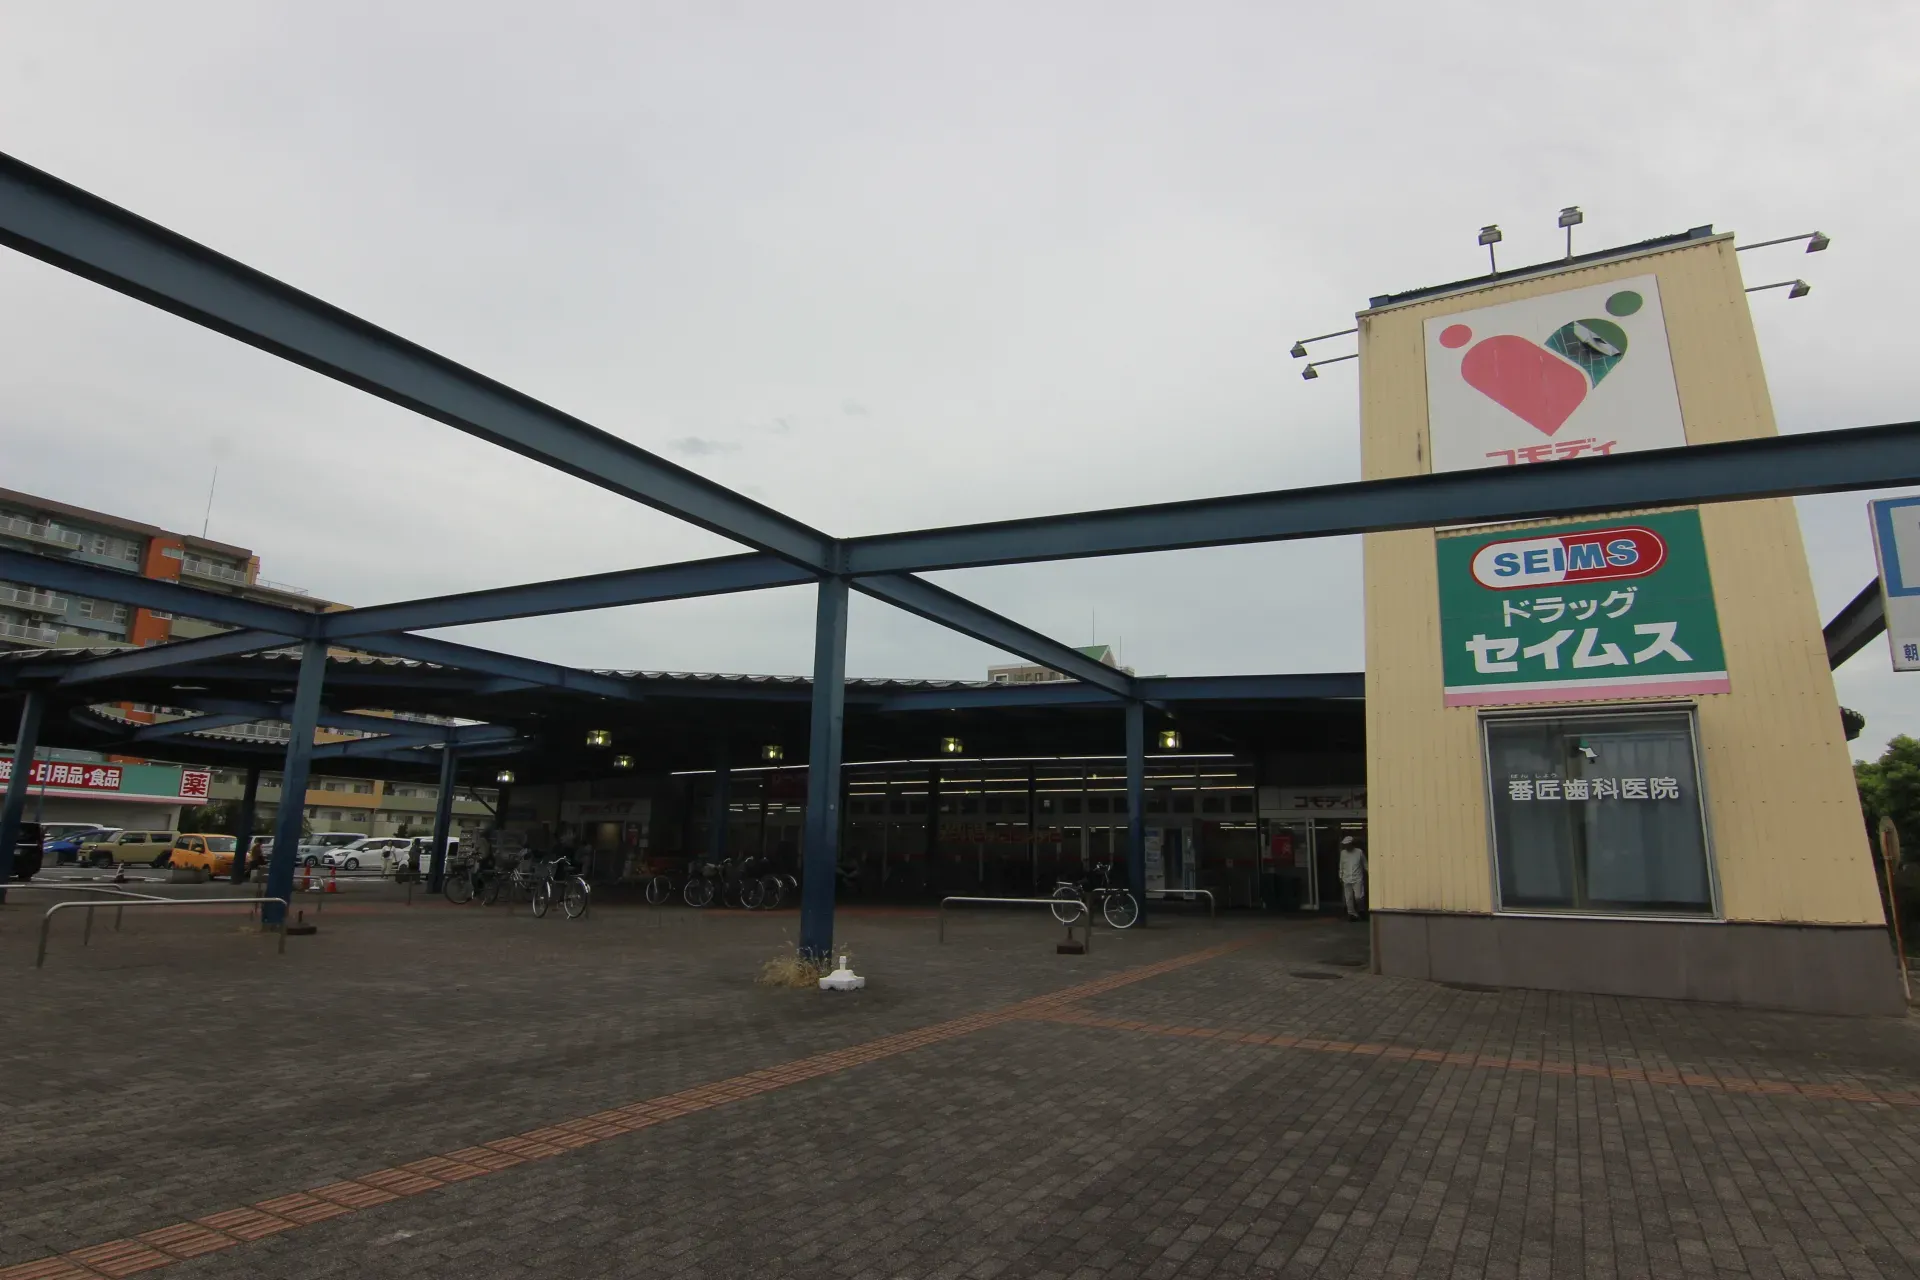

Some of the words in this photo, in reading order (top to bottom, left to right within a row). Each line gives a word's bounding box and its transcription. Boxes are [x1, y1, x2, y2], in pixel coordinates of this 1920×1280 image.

[1493, 539, 1640, 577] SEIMS
[1503, 586, 1639, 627] ドラッグ
[1465, 621, 1693, 674] セイムス
[183, 773, 207, 795] 薬
[1508, 777, 1679, 800] 番匠歯科医院
